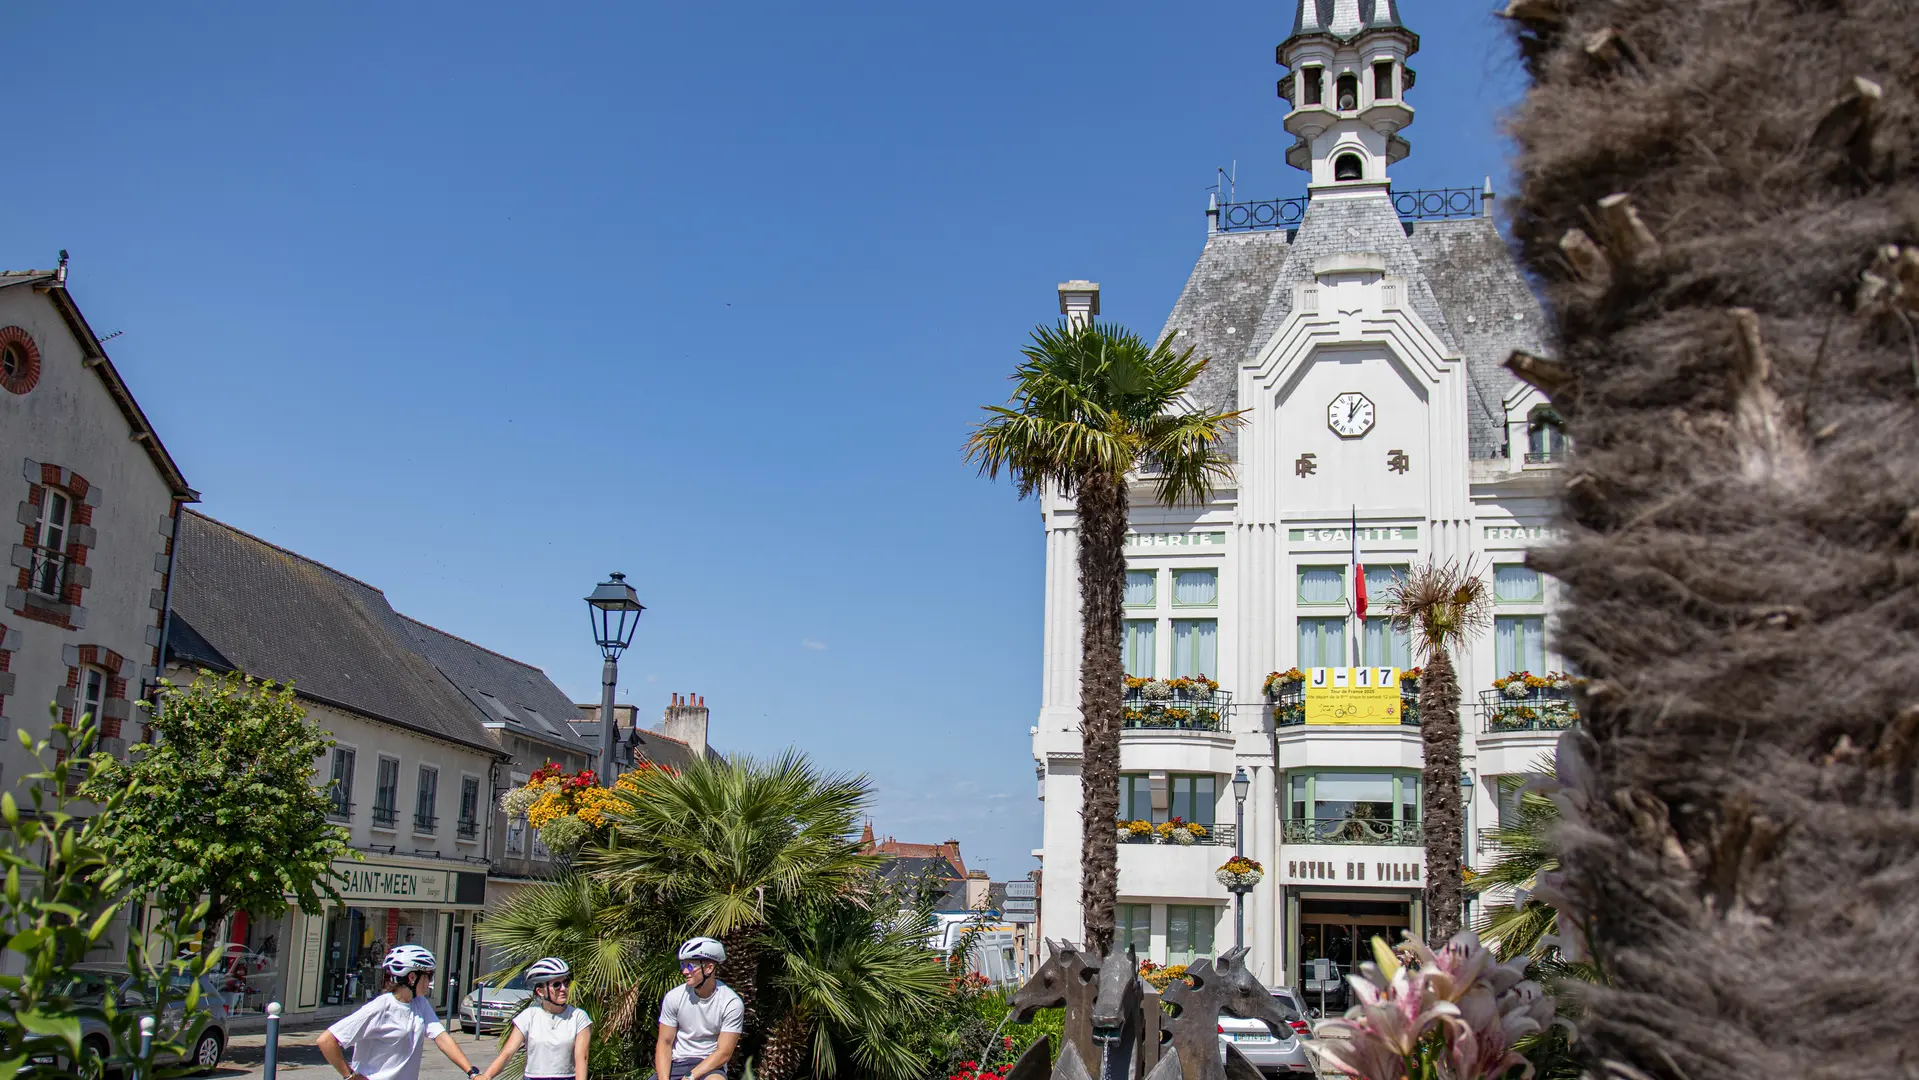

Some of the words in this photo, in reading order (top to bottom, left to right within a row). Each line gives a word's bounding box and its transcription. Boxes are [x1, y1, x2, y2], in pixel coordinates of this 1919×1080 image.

[1131, 533, 1212, 546] IBERTE
[342, 869, 418, 895] SAINT-MEEN
[1346, 862, 1366, 881] DE
[1376, 862, 1420, 882] VILLE
